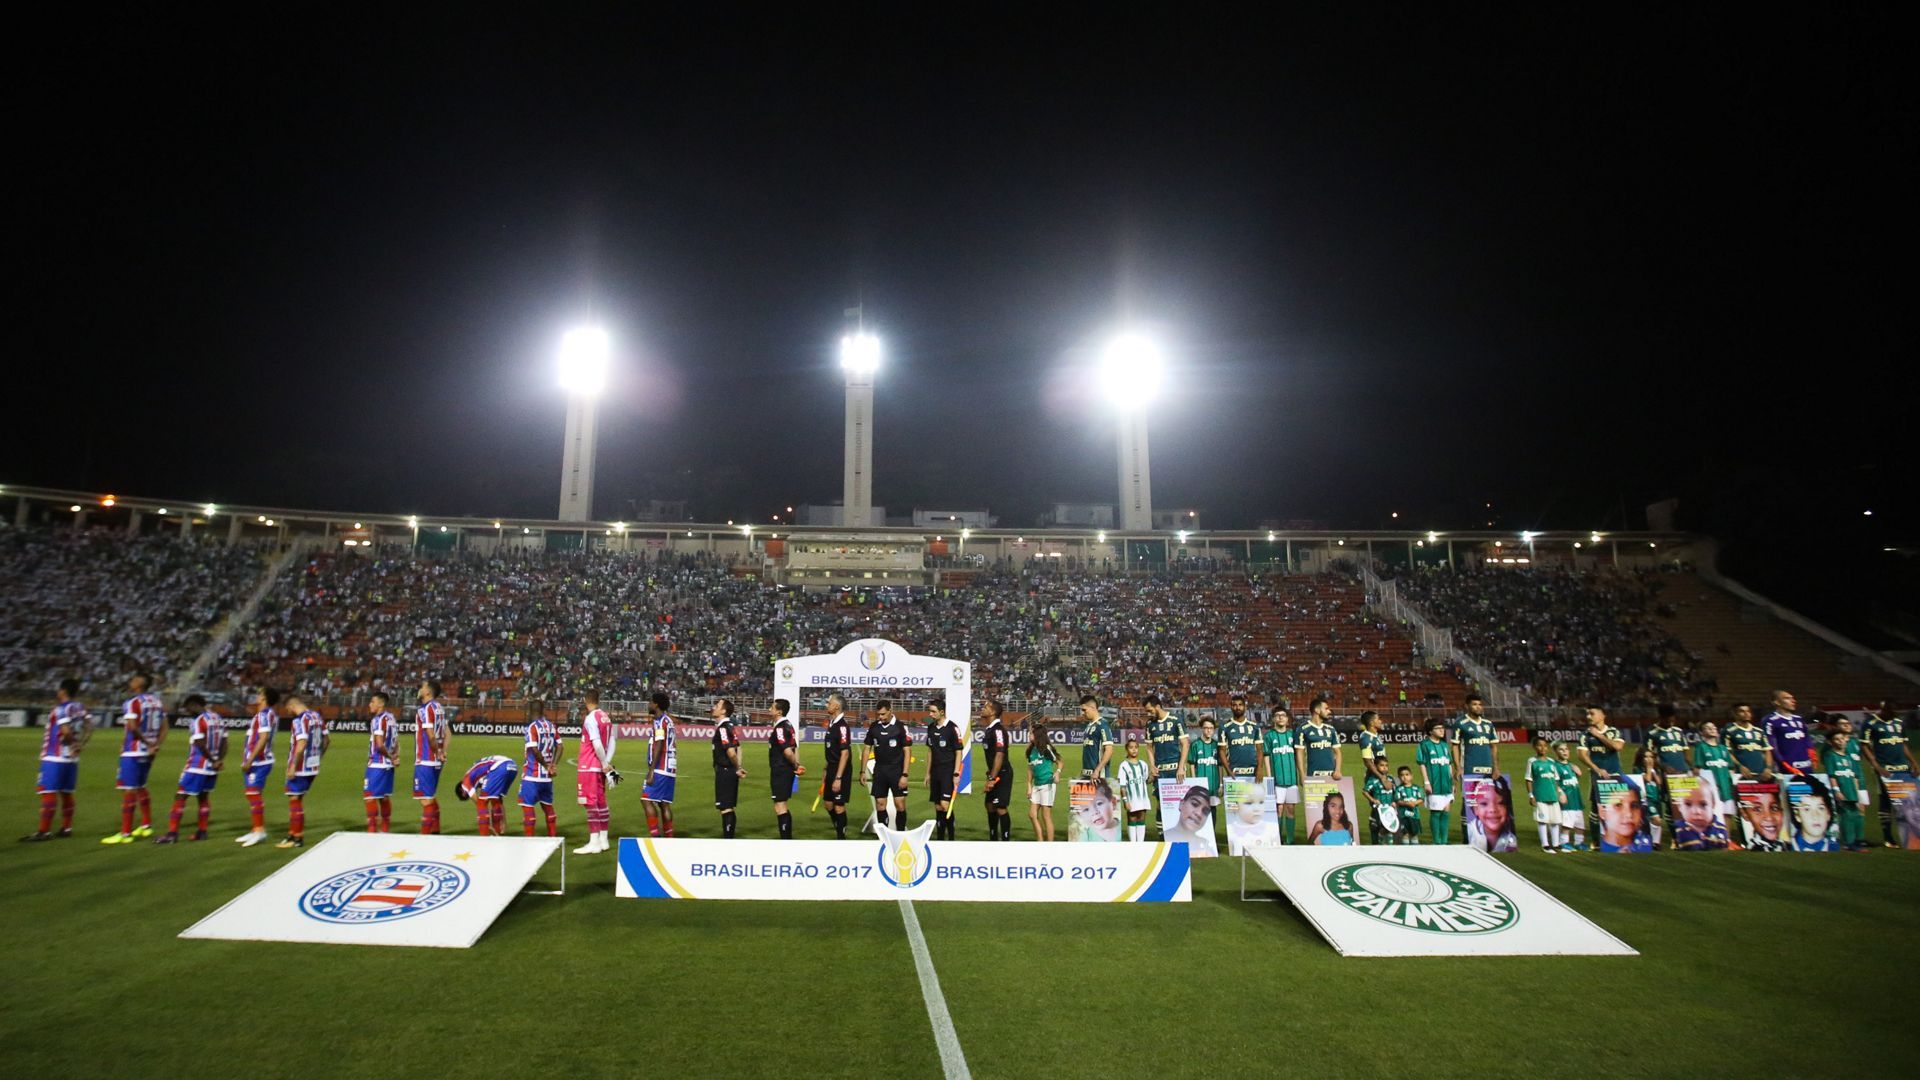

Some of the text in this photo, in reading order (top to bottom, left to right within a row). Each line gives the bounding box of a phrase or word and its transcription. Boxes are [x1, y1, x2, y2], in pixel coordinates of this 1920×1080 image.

[811, 674, 934, 686] BRASILEIRÃO 2017
[453, 722, 464, 733] VÊ
[466, 724, 494, 733] TUDO
[495, 724, 507, 734] DE
[558, 726, 582, 735] GLOBO
[690, 862, 873, 879] BRASILEIRÃO 2017
[936, 863, 1118, 880] BRASILEIRÃO 2017
[312, 864, 456, 909] ESPORTE CLUBE BAHIA
[337, 910, 378, 920] 1931
[1337, 890, 1509, 932] PALMEIRAS
